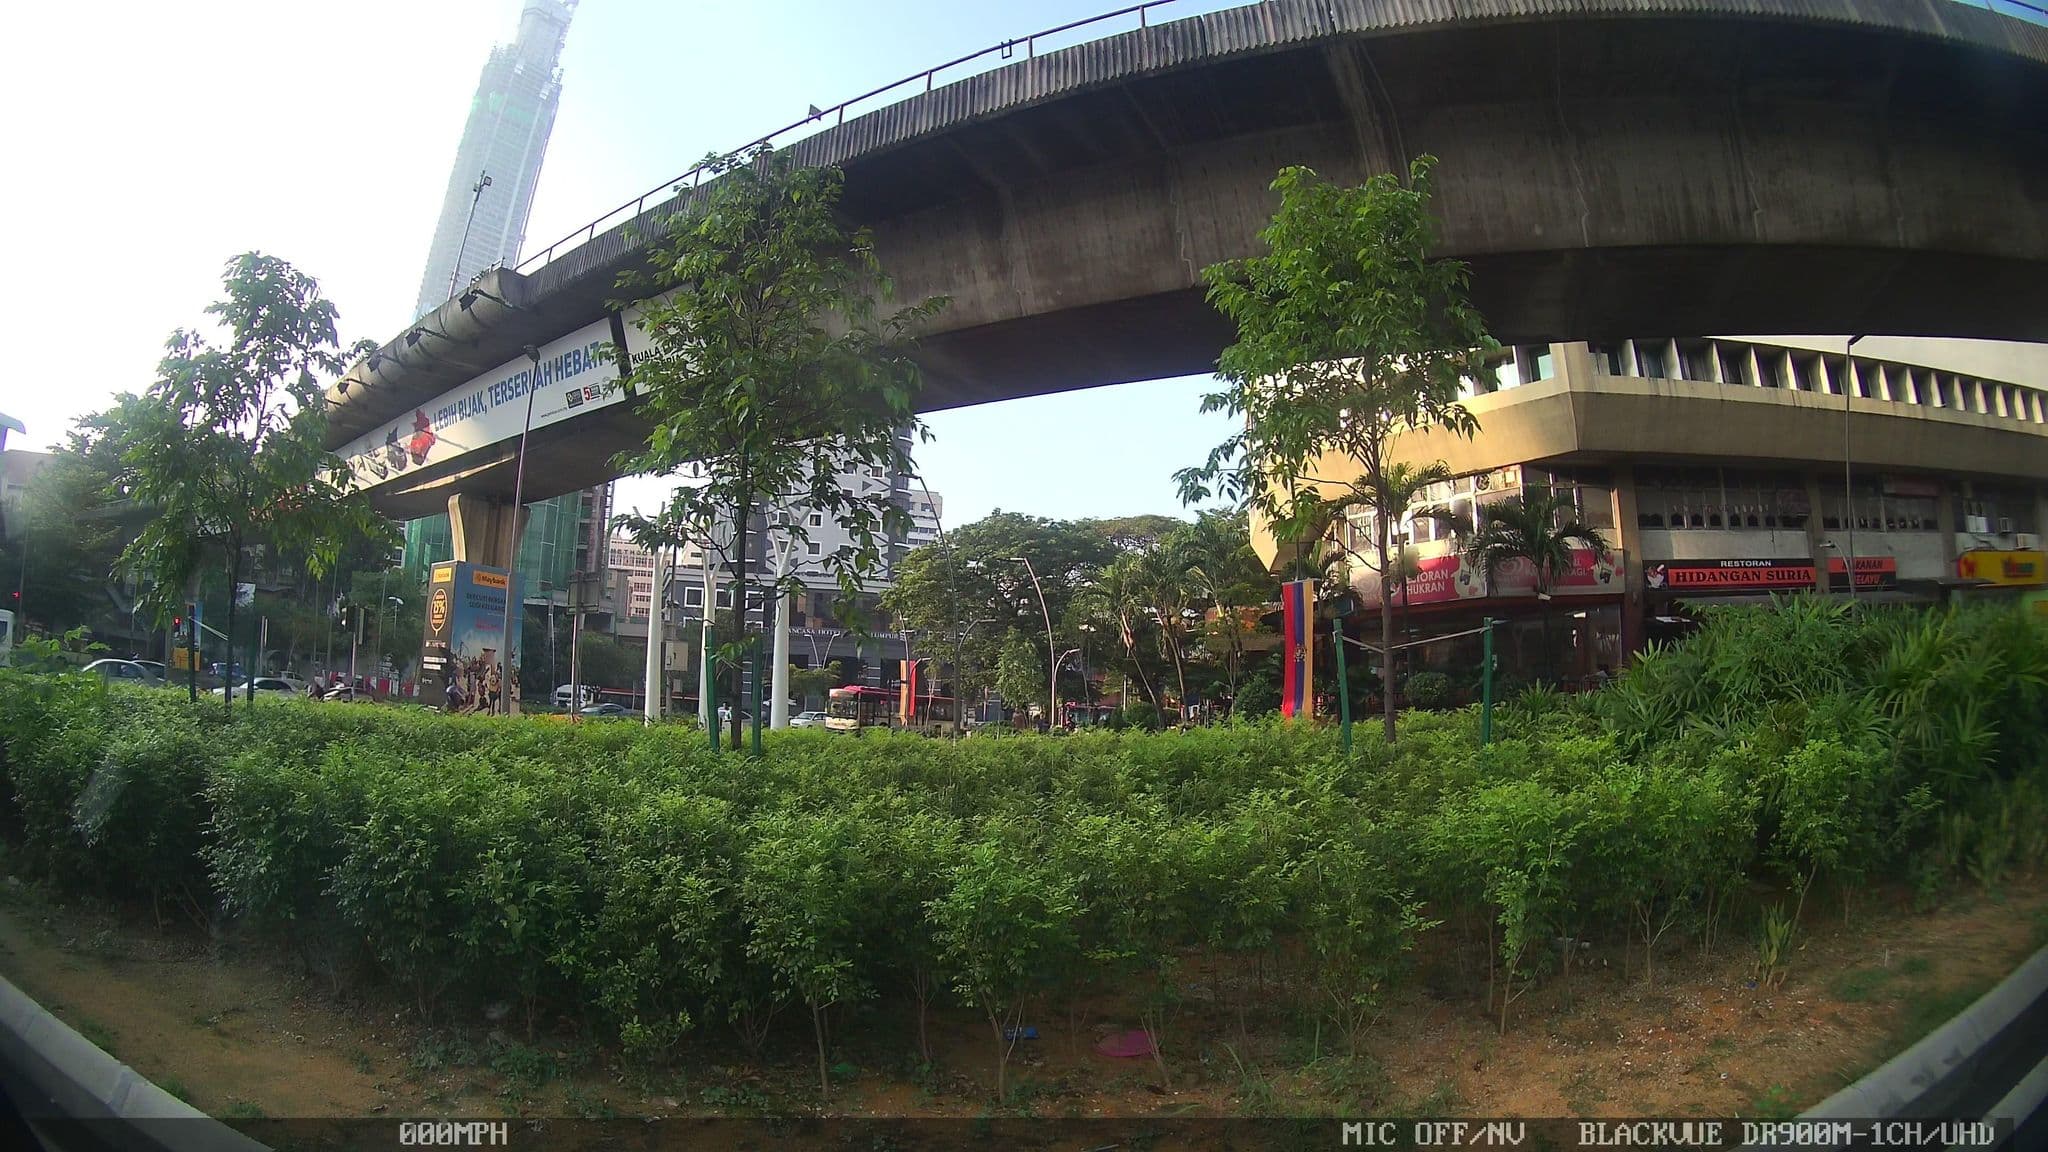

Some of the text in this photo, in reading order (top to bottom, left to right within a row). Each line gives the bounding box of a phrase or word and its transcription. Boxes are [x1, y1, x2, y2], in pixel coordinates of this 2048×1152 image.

[631, 346, 661, 365] KUALA
[433, 402, 458, 431] LEBIH
[458, 390, 488, 421] BIJAK,
[488, 360, 552, 409] TERSERLAH
[1675, 569, 1812, 583] HIDANGAN SURIA
